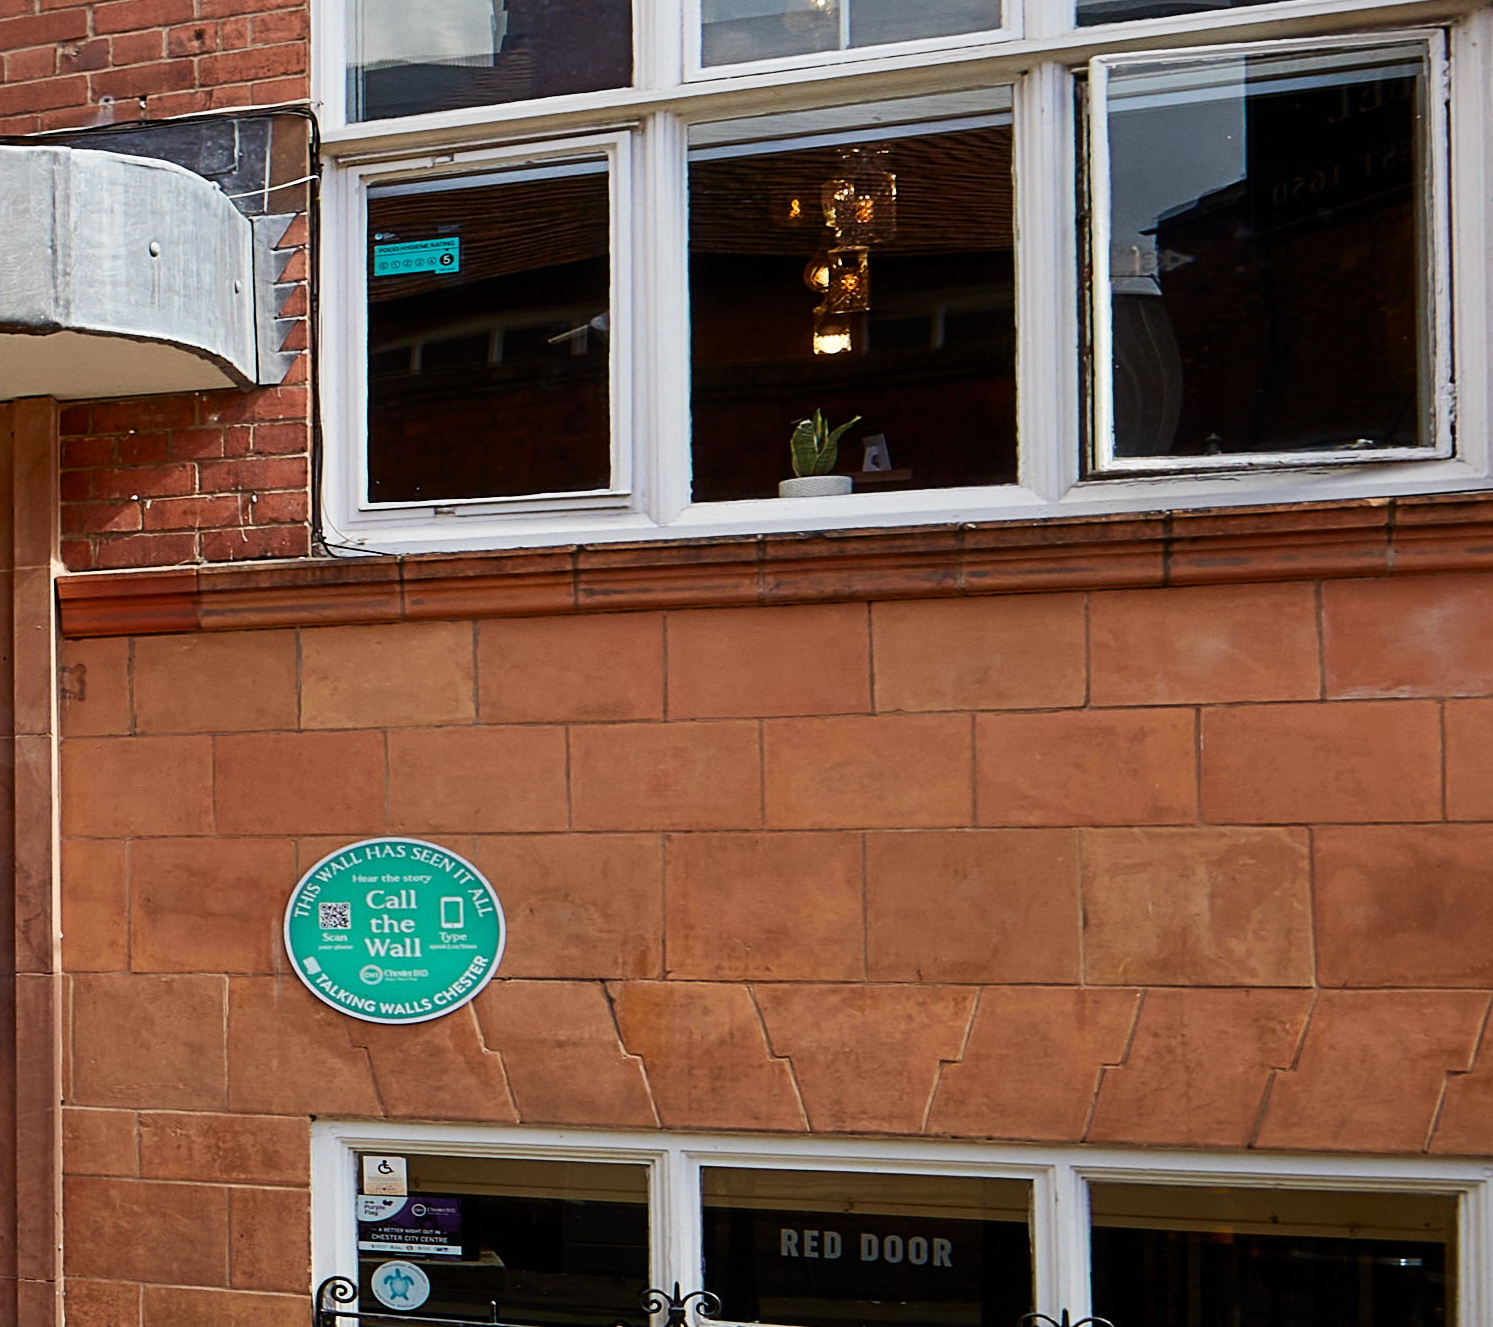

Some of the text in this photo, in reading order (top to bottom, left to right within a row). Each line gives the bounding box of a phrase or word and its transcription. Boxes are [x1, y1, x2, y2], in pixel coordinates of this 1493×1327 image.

[442, 254, 451, 264] 5
[293, 845, 493, 918] THIS WALL HAS SEEN IT ALL
[352, 874, 432, 884] Hear the story
[366, 889, 417, 909] Call
[370, 914, 415, 933] the
[322, 932, 348, 942] Scan
[438, 932, 467, 943] Type
[364, 938, 421, 957] Wall
[315, 955, 489, 1015] TALKING WALLS CHESTER
[404, 1234, 419, 1242] CITY
[420, 1235, 449, 1243] CENTRE
[780, 1228, 953, 1267] RED DOOR
